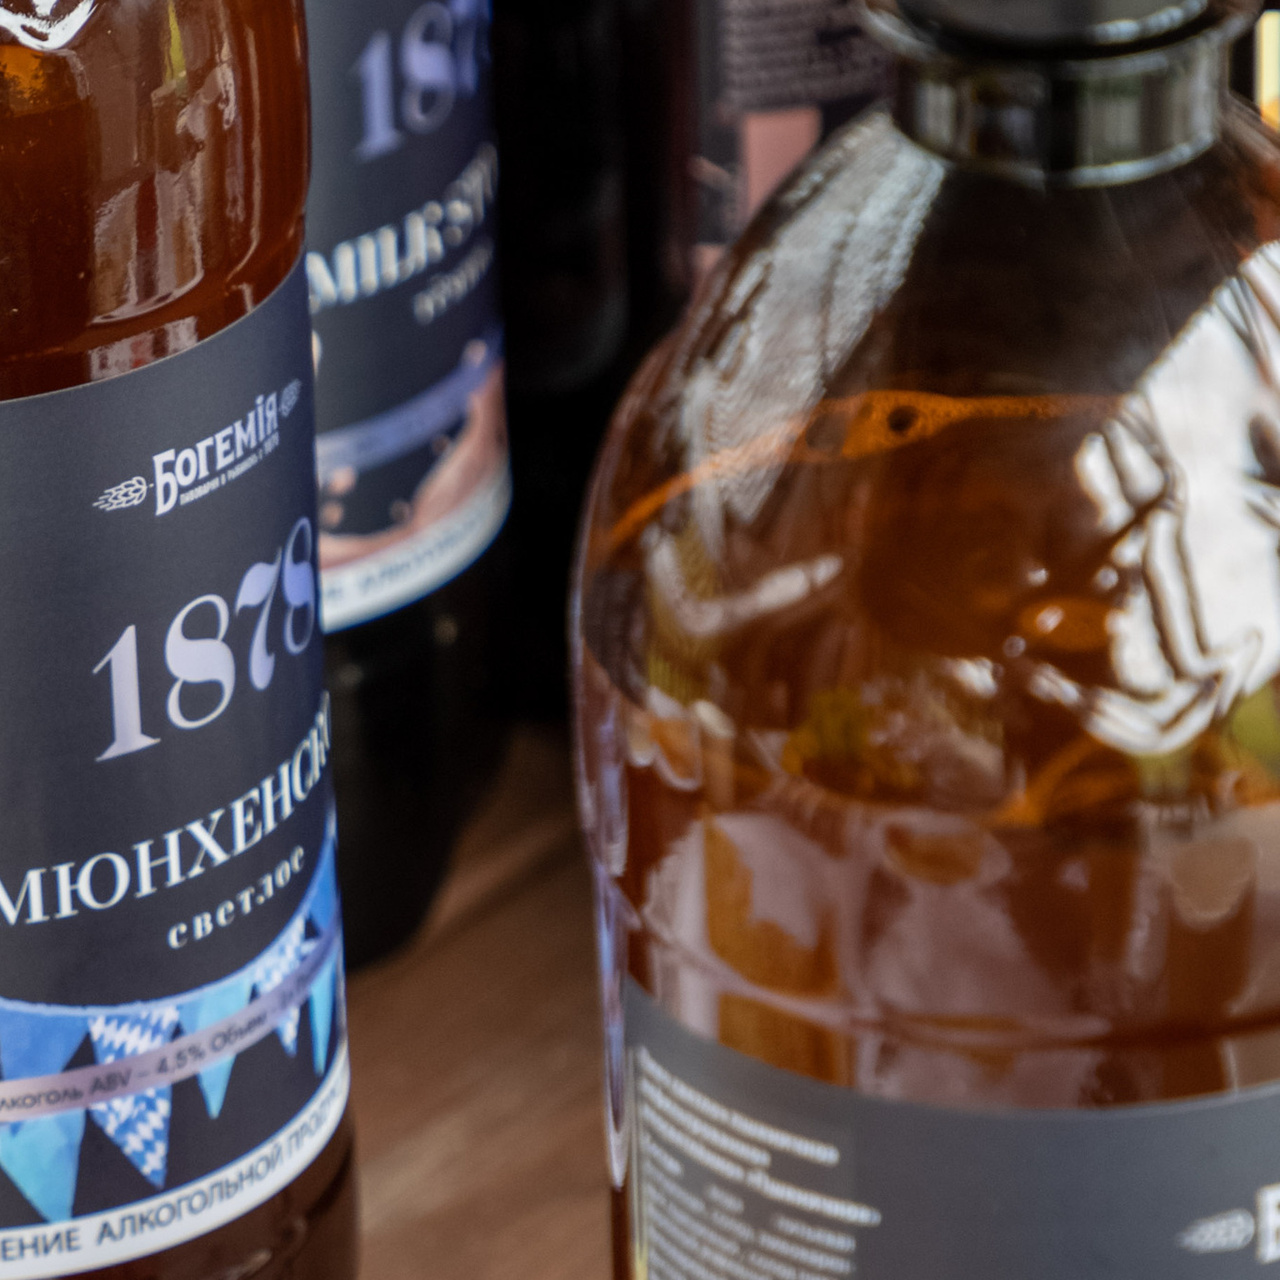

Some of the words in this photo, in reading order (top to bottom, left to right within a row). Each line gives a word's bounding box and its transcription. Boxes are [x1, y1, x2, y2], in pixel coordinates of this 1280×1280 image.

[92, 516, 315, 762] 1878
[168, 845, 305, 950] светлое
[89, 1069, 135, 1097] ABV
[95, 1140, 283, 1246] АЛКОГОЛЬНОЙ
